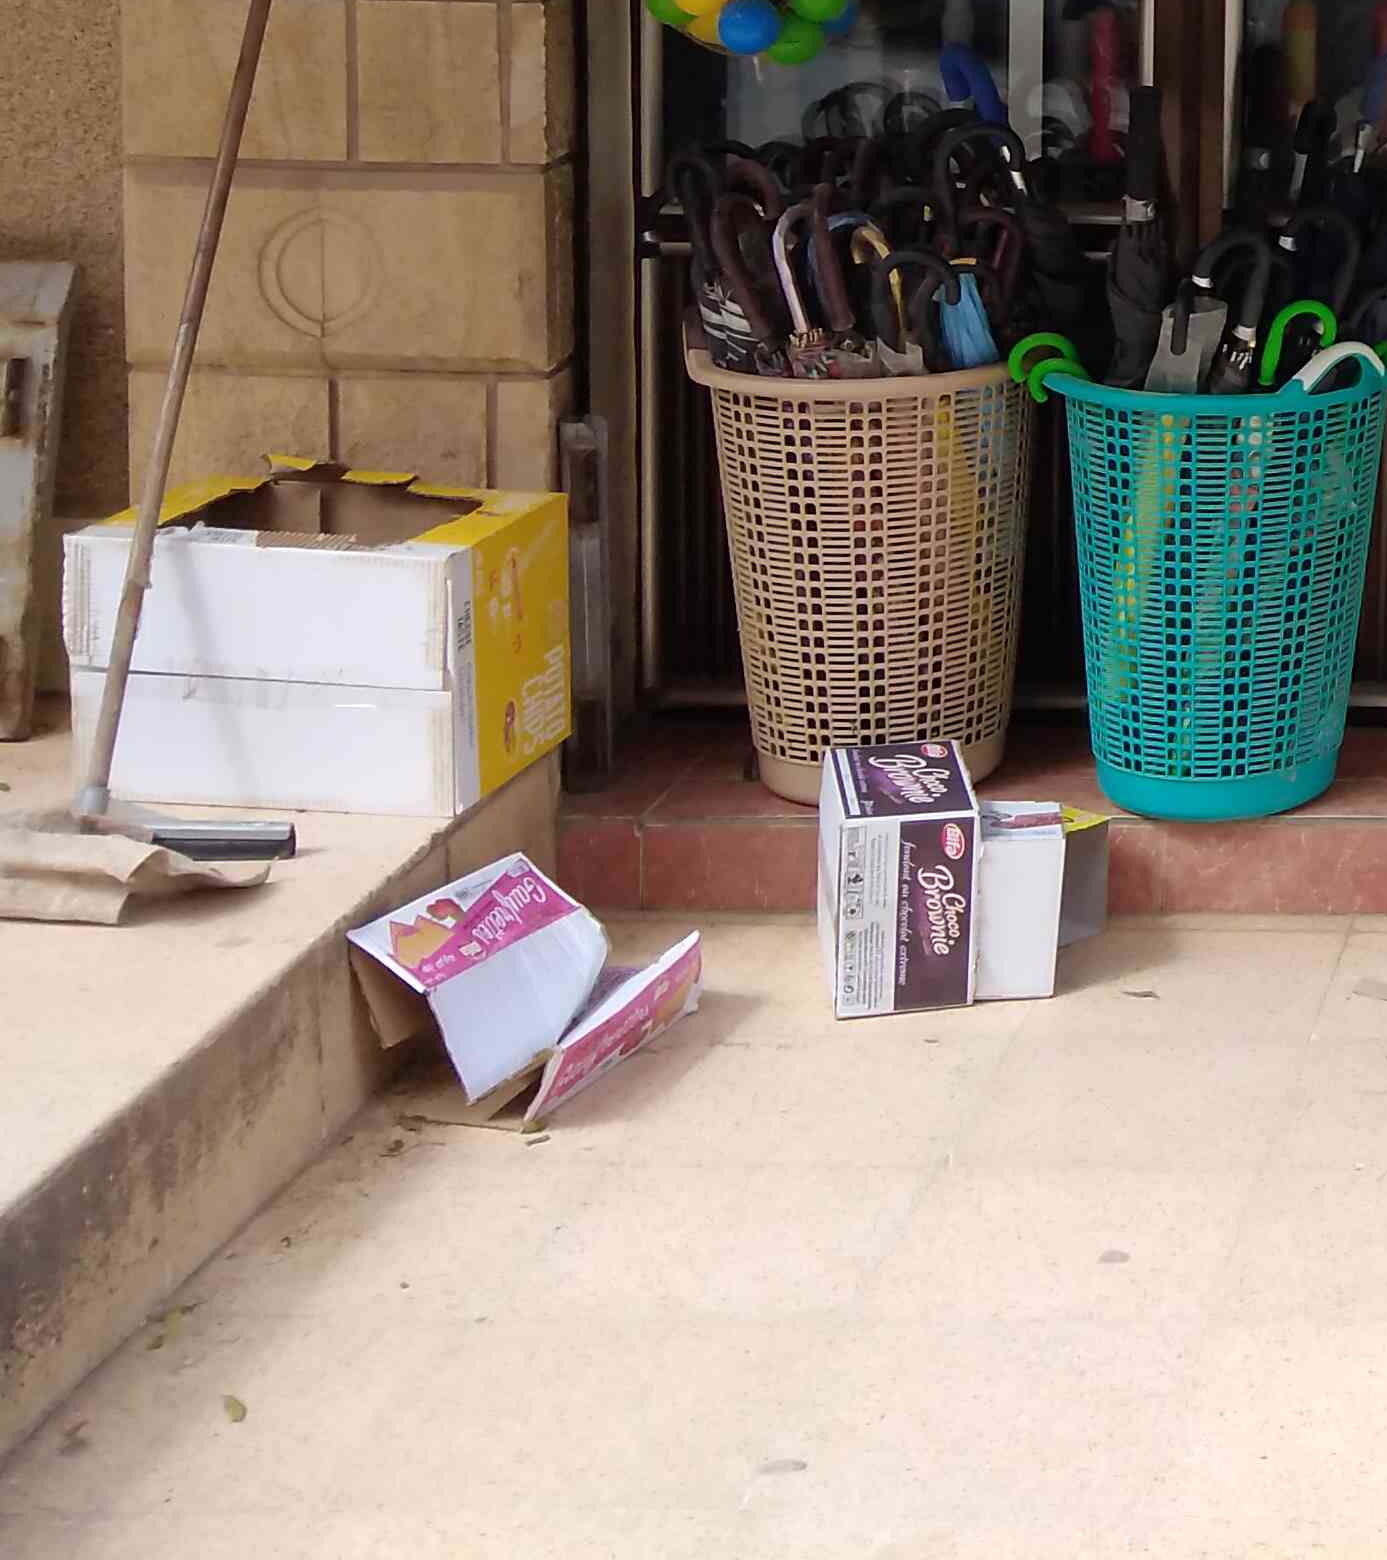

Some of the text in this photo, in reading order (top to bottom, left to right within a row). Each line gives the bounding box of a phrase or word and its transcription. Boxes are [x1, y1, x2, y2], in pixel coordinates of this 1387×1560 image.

[522, 675, 545, 755] CHIPS
[543, 646, 566, 741] POTATO
[868, 753, 934, 804] Brownie
[912, 767, 950, 797] Choco
[471, 876, 547, 948] Gaufrettes
[917, 864, 953, 957] Brownie
[941, 892, 966, 940] Choco
